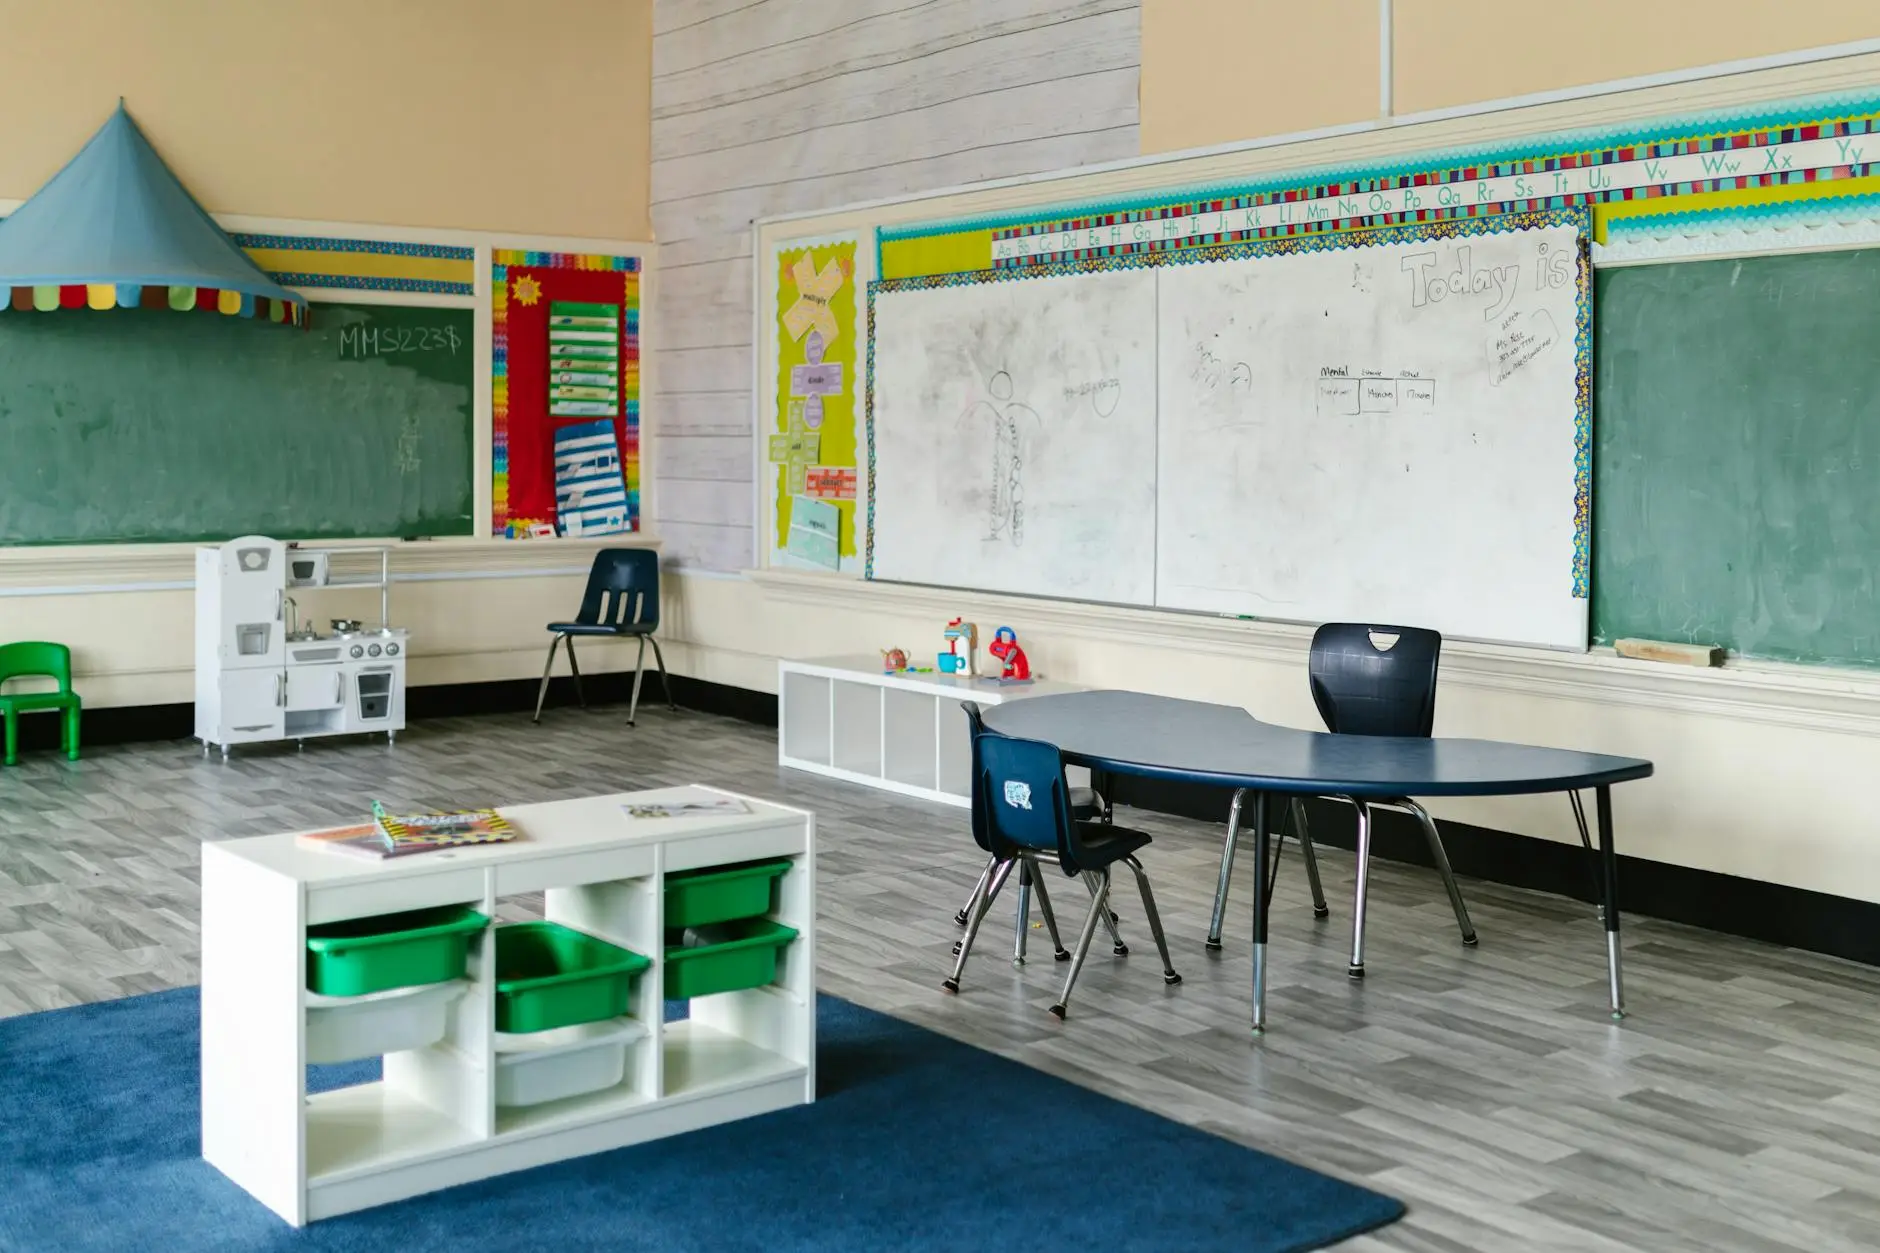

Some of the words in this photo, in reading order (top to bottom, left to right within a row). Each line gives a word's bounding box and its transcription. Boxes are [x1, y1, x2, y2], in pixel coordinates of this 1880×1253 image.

[998, 243, 1012, 257] Aa
[1018, 239, 1030, 254] Bb
[1039, 236, 1052, 250] Cc
[1062, 233, 1077, 249] Dd
[1089, 230, 1100, 246] Ee
[1111, 227, 1121, 244] Ff
[1133, 224, 1150, 241] Gg
[1162, 221, 1179, 238] Hh
[1191, 217, 1200, 234] Ii
[1216, 213, 1228, 232] Jj
[1245, 209, 1261, 228] Kk
[1279, 205, 1292, 223] Ll
[1307, 204, 1329, 220] Mm
[1338, 199, 1359, 218] Nn
[1368, 193, 1392, 212] Oo
[1404, 189, 1421, 210] Pp
[1438, 186, 1461, 207] Qq
[1477, 181, 1494, 202] Rr
[1514, 176, 1534, 198] Ss
[1552, 172, 1569, 193] Tt
[1588, 168, 1611, 189] Uu
[1644, 160, 1668, 182] Vv
[1700, 153, 1741, 176] Ww
[1764, 147, 1793, 172] Xx
[1836, 138, 1863, 172] Yy
[1401, 245, 1520, 321] Today
[1535, 243, 1570, 291] is
